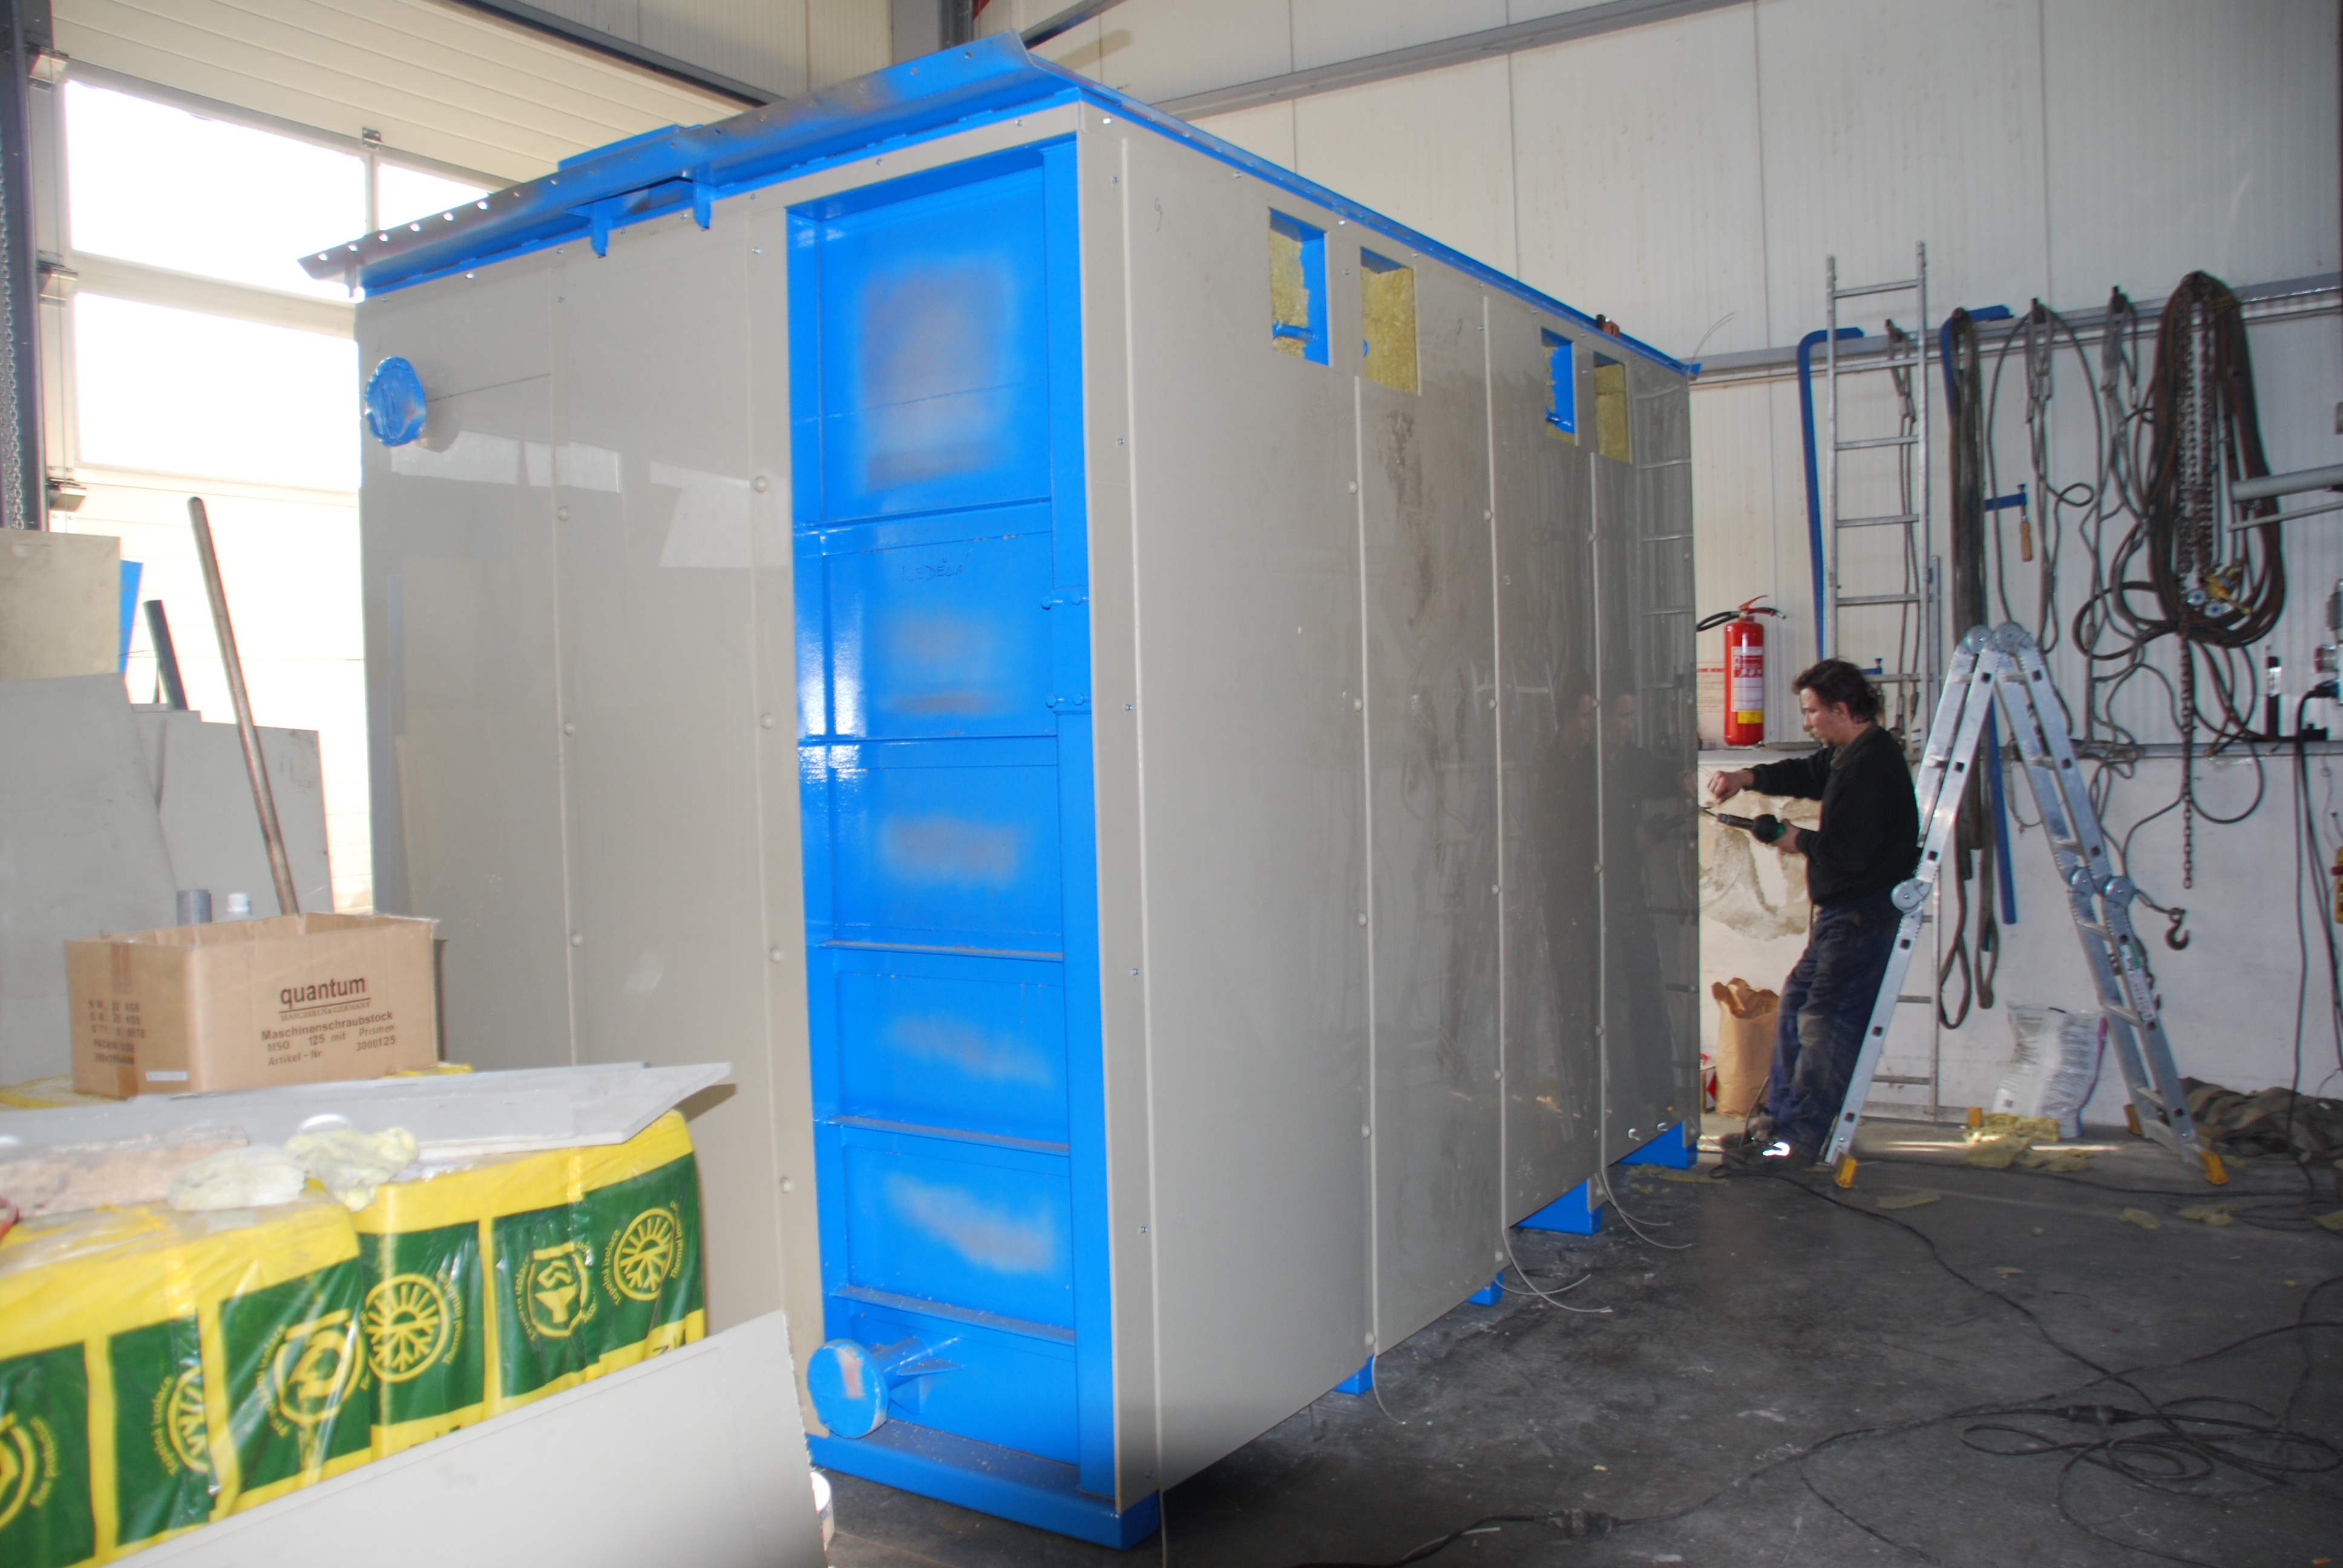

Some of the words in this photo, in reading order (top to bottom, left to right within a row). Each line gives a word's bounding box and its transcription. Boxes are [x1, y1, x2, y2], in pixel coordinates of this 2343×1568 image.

[280, 978, 366, 1009] quantum
[261, 1011, 393, 1041] Maschinenschraubstock
[267, 1040, 290, 1053] MSO
[307, 1034, 325, 1046] 125
[330, 1033, 346, 1042] mit
[359, 1025, 395, 1037] Prismen
[268, 1053, 301, 1066] Artikel
[310, 1050, 322, 1059] Nr
[356, 1035, 396, 1051] 3000125
[601, 1229, 621, 1267] izolace
[669, 1240, 683, 1279] Thermal
[435, 1270, 462, 1321] insulation
[601, 1268, 621, 1307] Tepelná
[441, 1319, 462, 1365] Thermal
[151, 1376, 174, 1426] izolace
[151, 1427, 179, 1476] Tepelná
